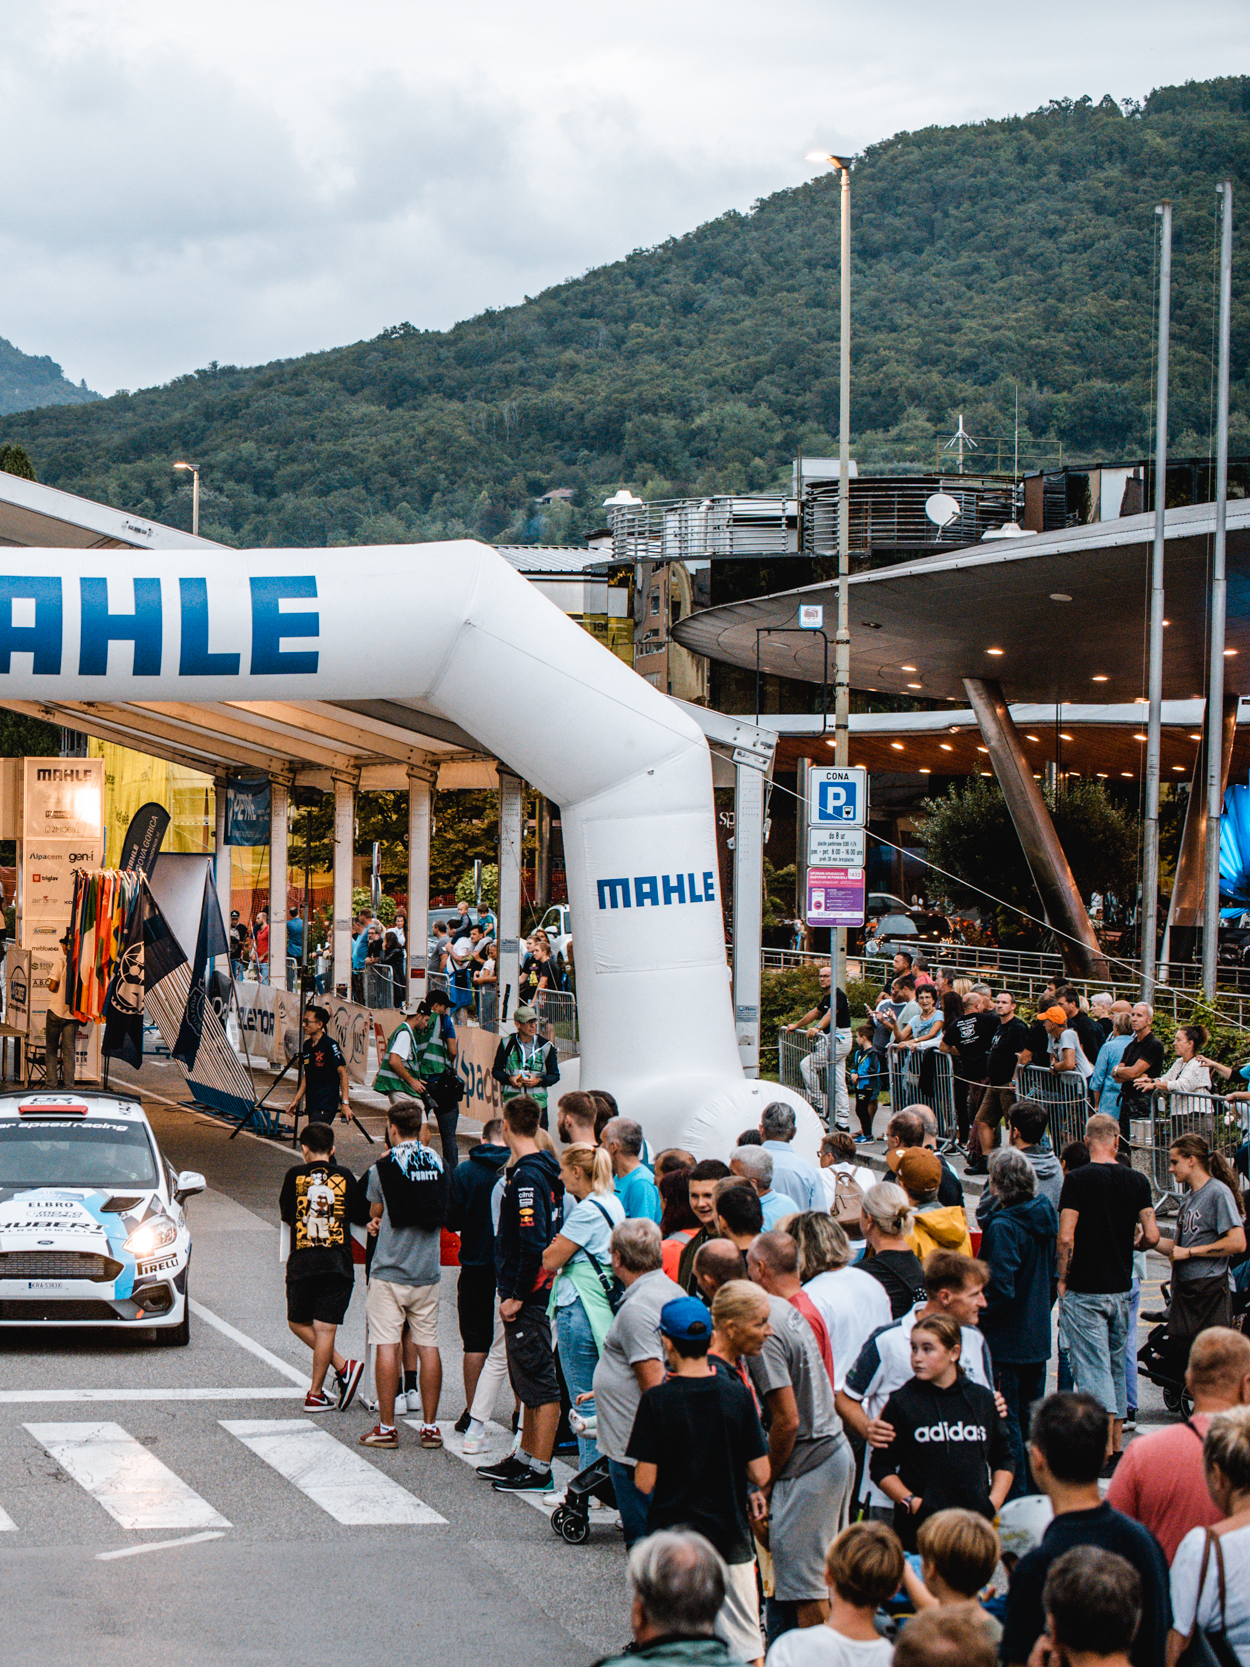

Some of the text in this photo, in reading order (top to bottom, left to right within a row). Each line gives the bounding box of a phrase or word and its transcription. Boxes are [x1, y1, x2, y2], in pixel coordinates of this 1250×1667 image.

[826, 772, 850, 780] CONA
[827, 786, 847, 814] P
[51, 826, 81, 834] 2MOBILE
[30, 852, 62, 860] Alpacem
[68, 850, 94, 863] gen-i
[41, 875, 59, 883] triglav
[597, 871, 715, 910] MAHLE
[18, 1121, 72, 1129] speed
[72, 1122, 129, 1132] racing
[410, 1170, 438, 1181] PURITY
[136, 1252, 179, 1276] PIRELLI
[913, 1420, 987, 1443] adidas
